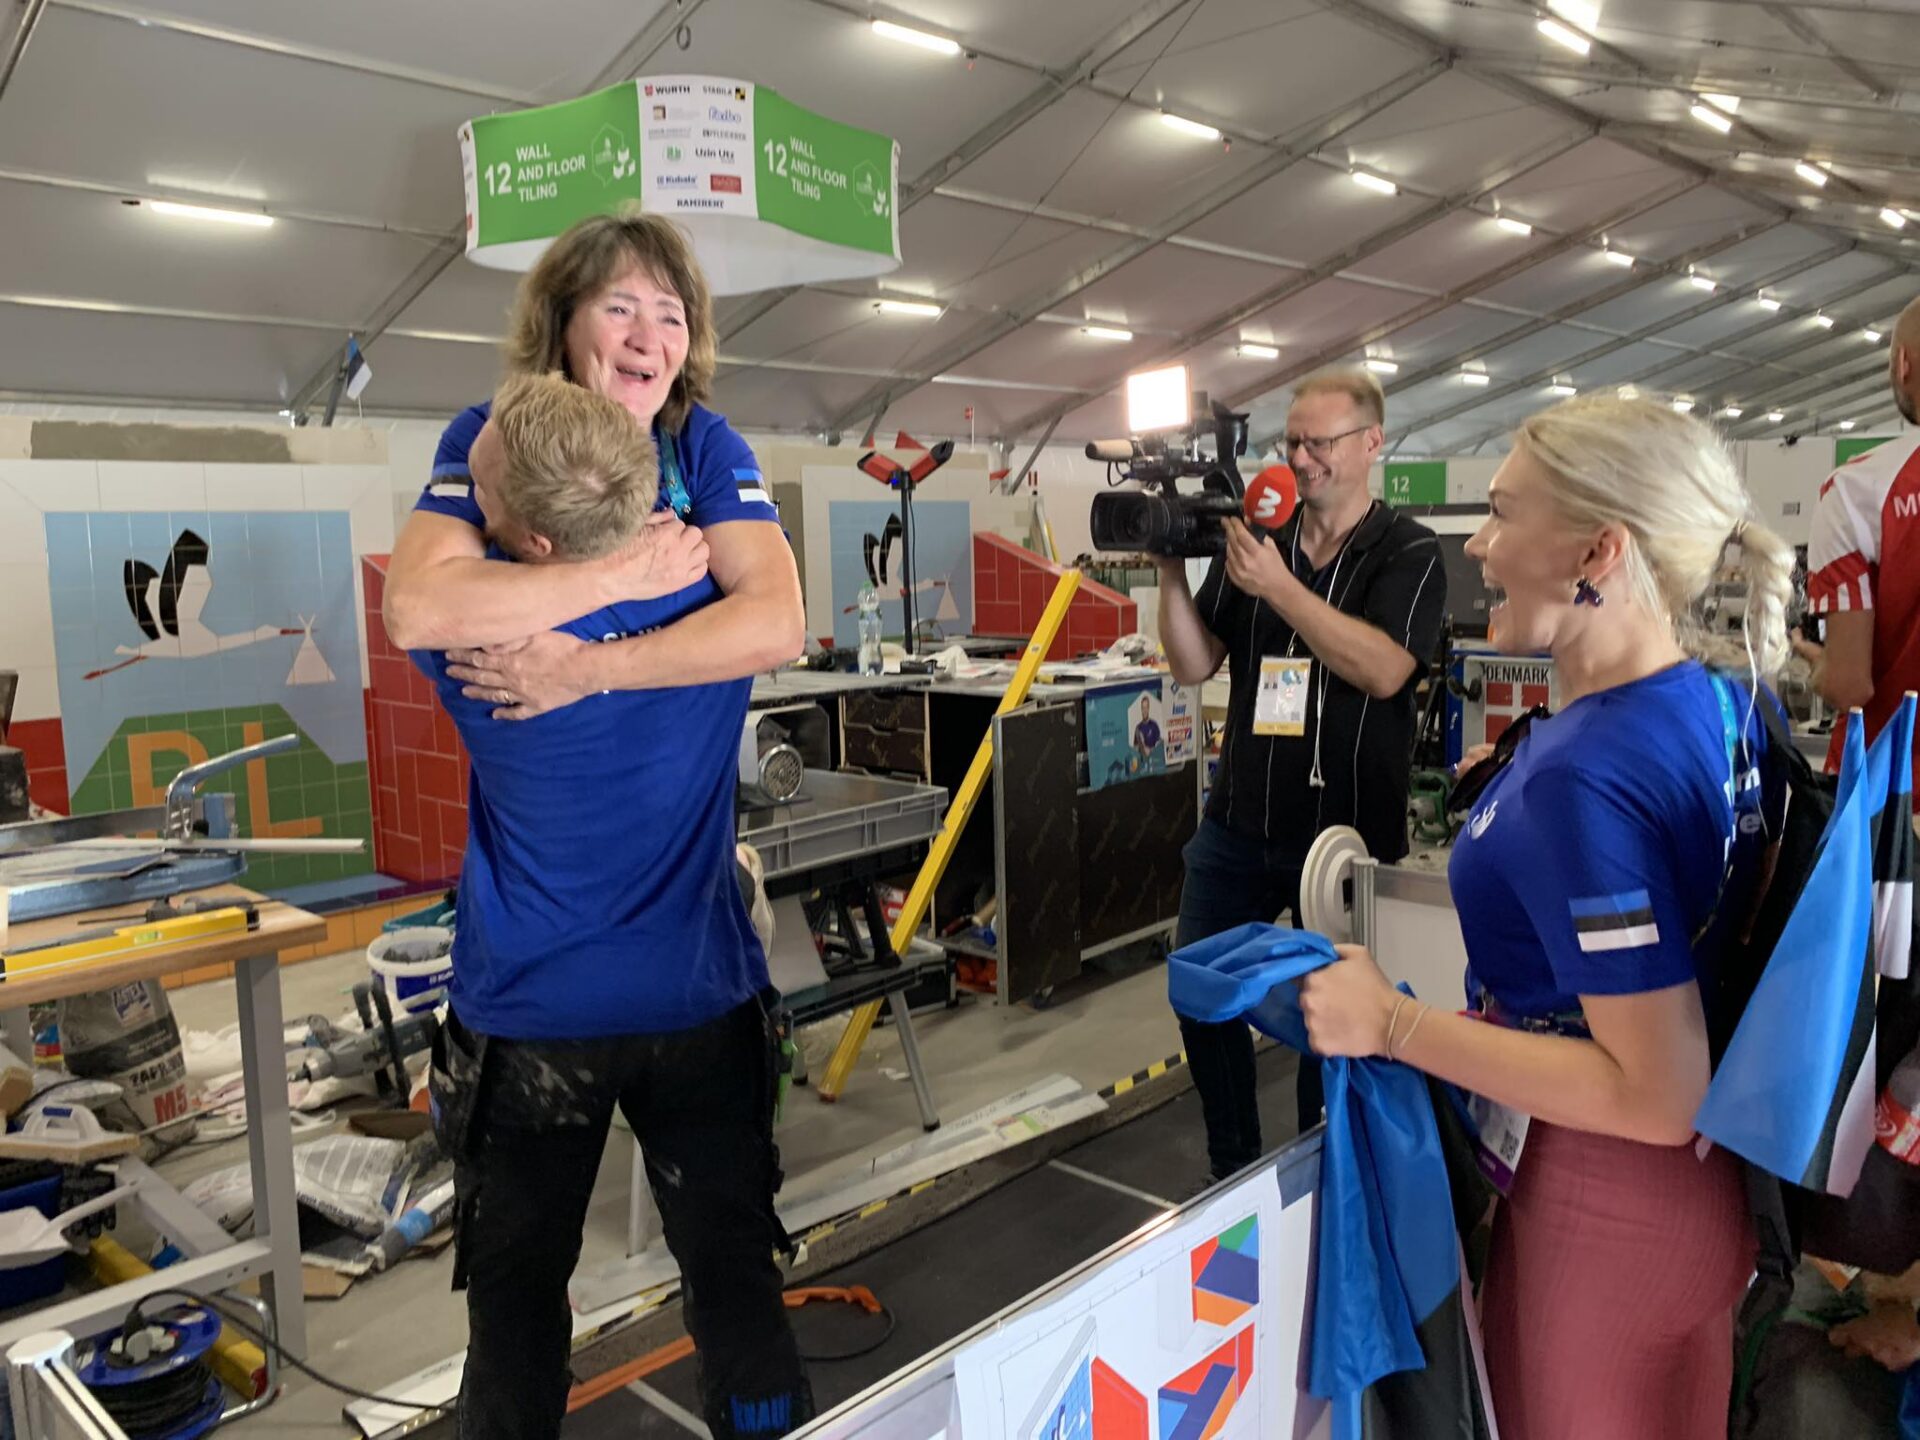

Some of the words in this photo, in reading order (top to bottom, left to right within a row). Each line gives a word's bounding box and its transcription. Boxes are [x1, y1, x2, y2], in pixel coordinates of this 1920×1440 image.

[516, 143, 550, 162] WALL
[695, 147, 716, 158] Uzin
[719, 149, 734, 159] Utz
[764, 139, 787, 178] 12
[790, 136, 816, 160] WALL
[484, 162, 512, 197] 12
[518, 165, 543, 183] AND
[547, 154, 585, 178] FLOOR
[791, 158, 810, 177] AND
[812, 165, 847, 189] FLOOR
[518, 182, 557, 202] TILING
[791, 177, 820, 201] TILING
[1391, 475, 1410, 494] 12
[1390, 495, 1410, 505] WALL
[1486, 664, 1550, 684] DENMARK
[154, 1083, 188, 1125] M5
